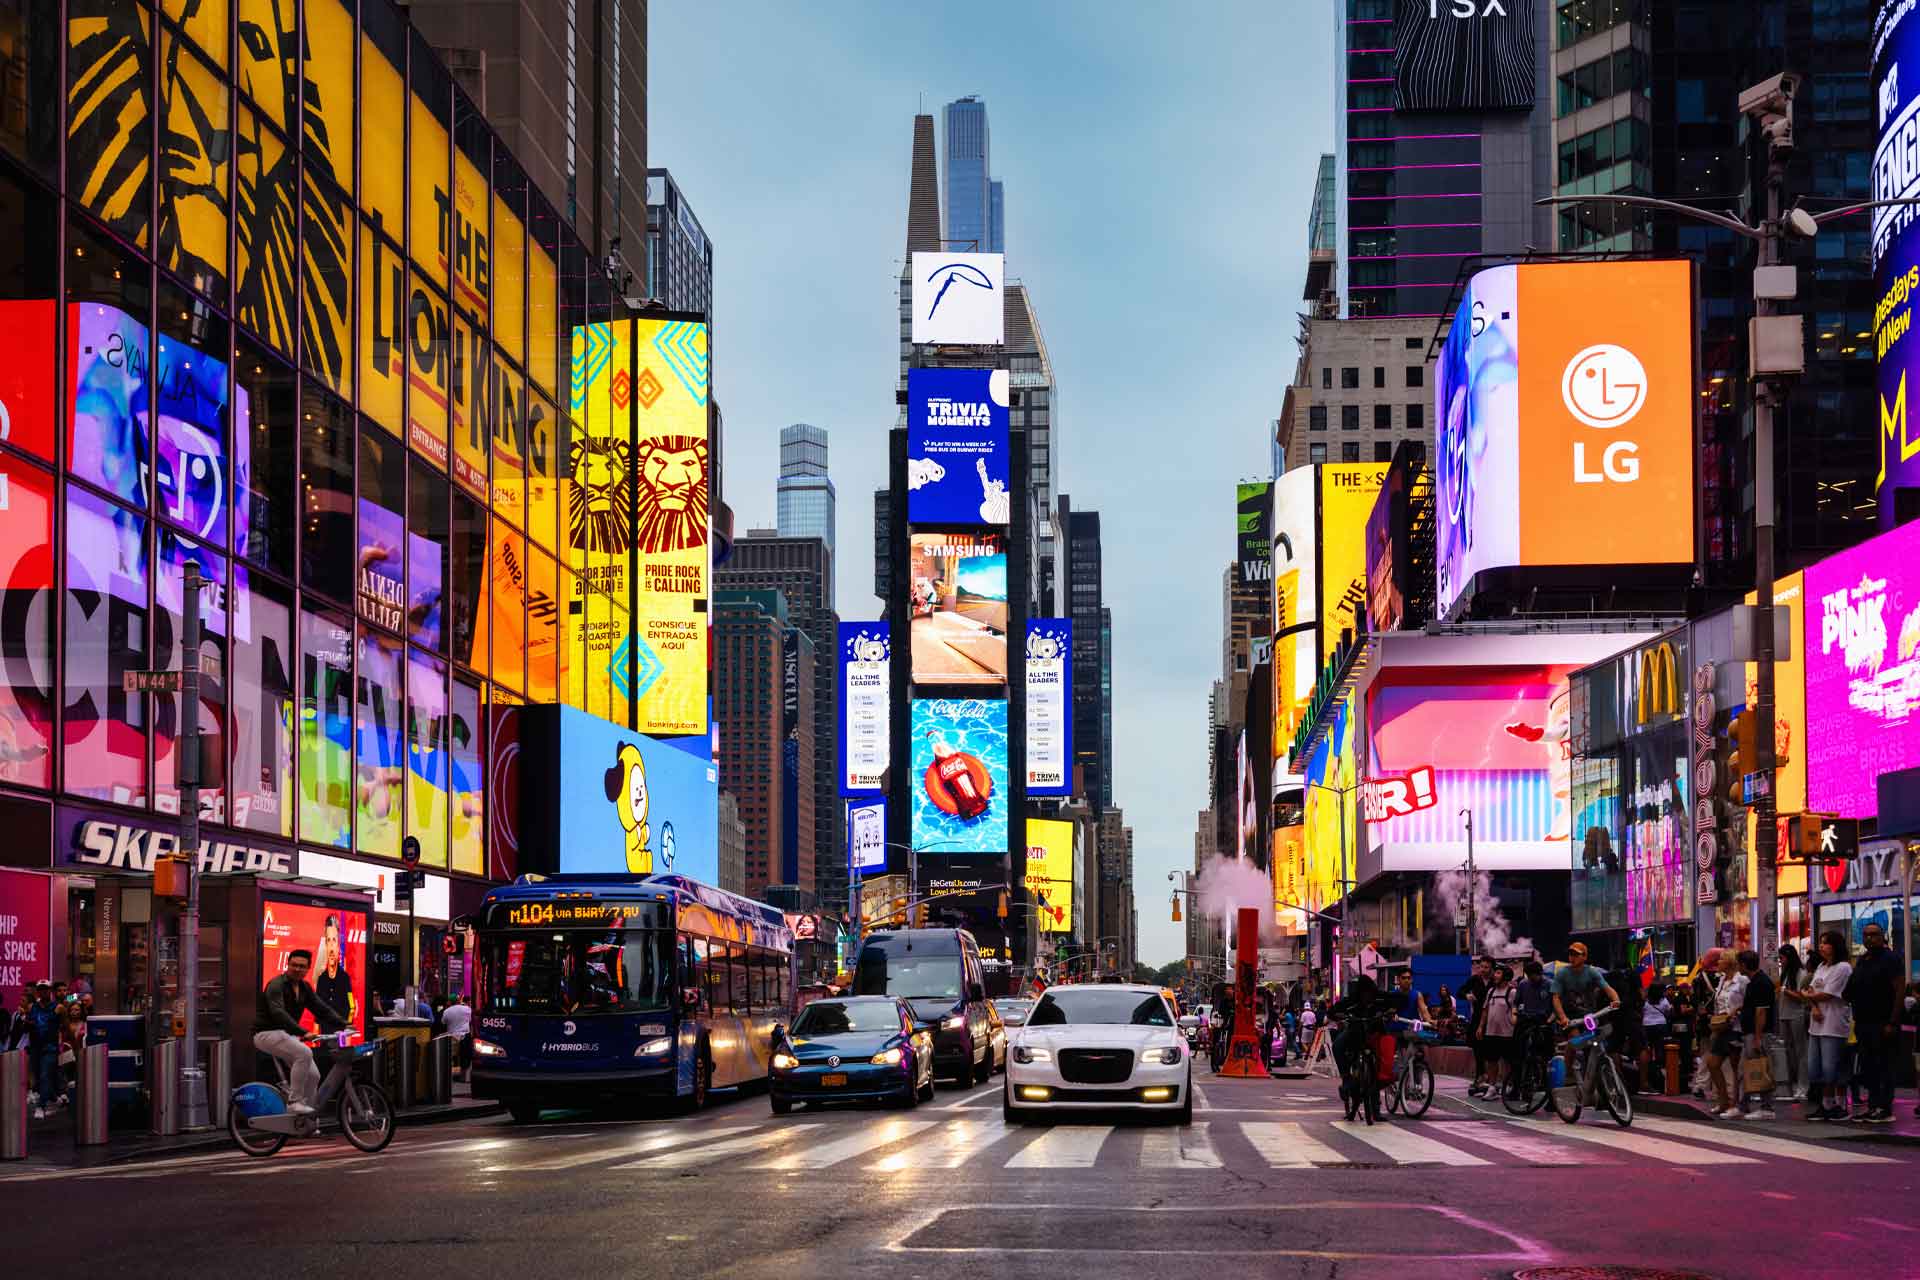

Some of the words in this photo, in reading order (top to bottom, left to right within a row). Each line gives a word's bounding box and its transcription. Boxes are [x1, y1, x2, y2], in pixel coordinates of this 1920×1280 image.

[434, 184, 488, 300] THE
[372, 207, 463, 407] LION
[1887, 308, 1911, 349] New
[469, 306, 546, 478] KING
[928, 402, 990, 416] TRIVIA
[928, 415, 991, 426] MOMENTS
[412, 424, 447, 461] ENTRANCE
[456, 458, 467, 475] ON
[1573, 441, 1640, 483] LG
[1332, 472, 1361, 486] THE
[923, 544, 995, 557] SAMSUNG
[645, 564, 674, 578] PRIDE
[675, 564, 701, 578] ROCK
[645, 580, 652, 592] IS
[653, 578, 702, 594] CALLING
[649, 620, 697, 630] CONSIGUE
[648, 630, 698, 640] ENTRADAS
[138, 674, 148, 687] W
[150, 674, 166, 687] 44
[648, 721, 698, 731] lionking.com
[79, 820, 293, 874] SKEHERS
[510, 904, 554, 925] M104
[377, 921, 400, 934] TISSOT
[4, 941, 37, 962] SPACE
[482, 1017, 506, 1028] 9455
